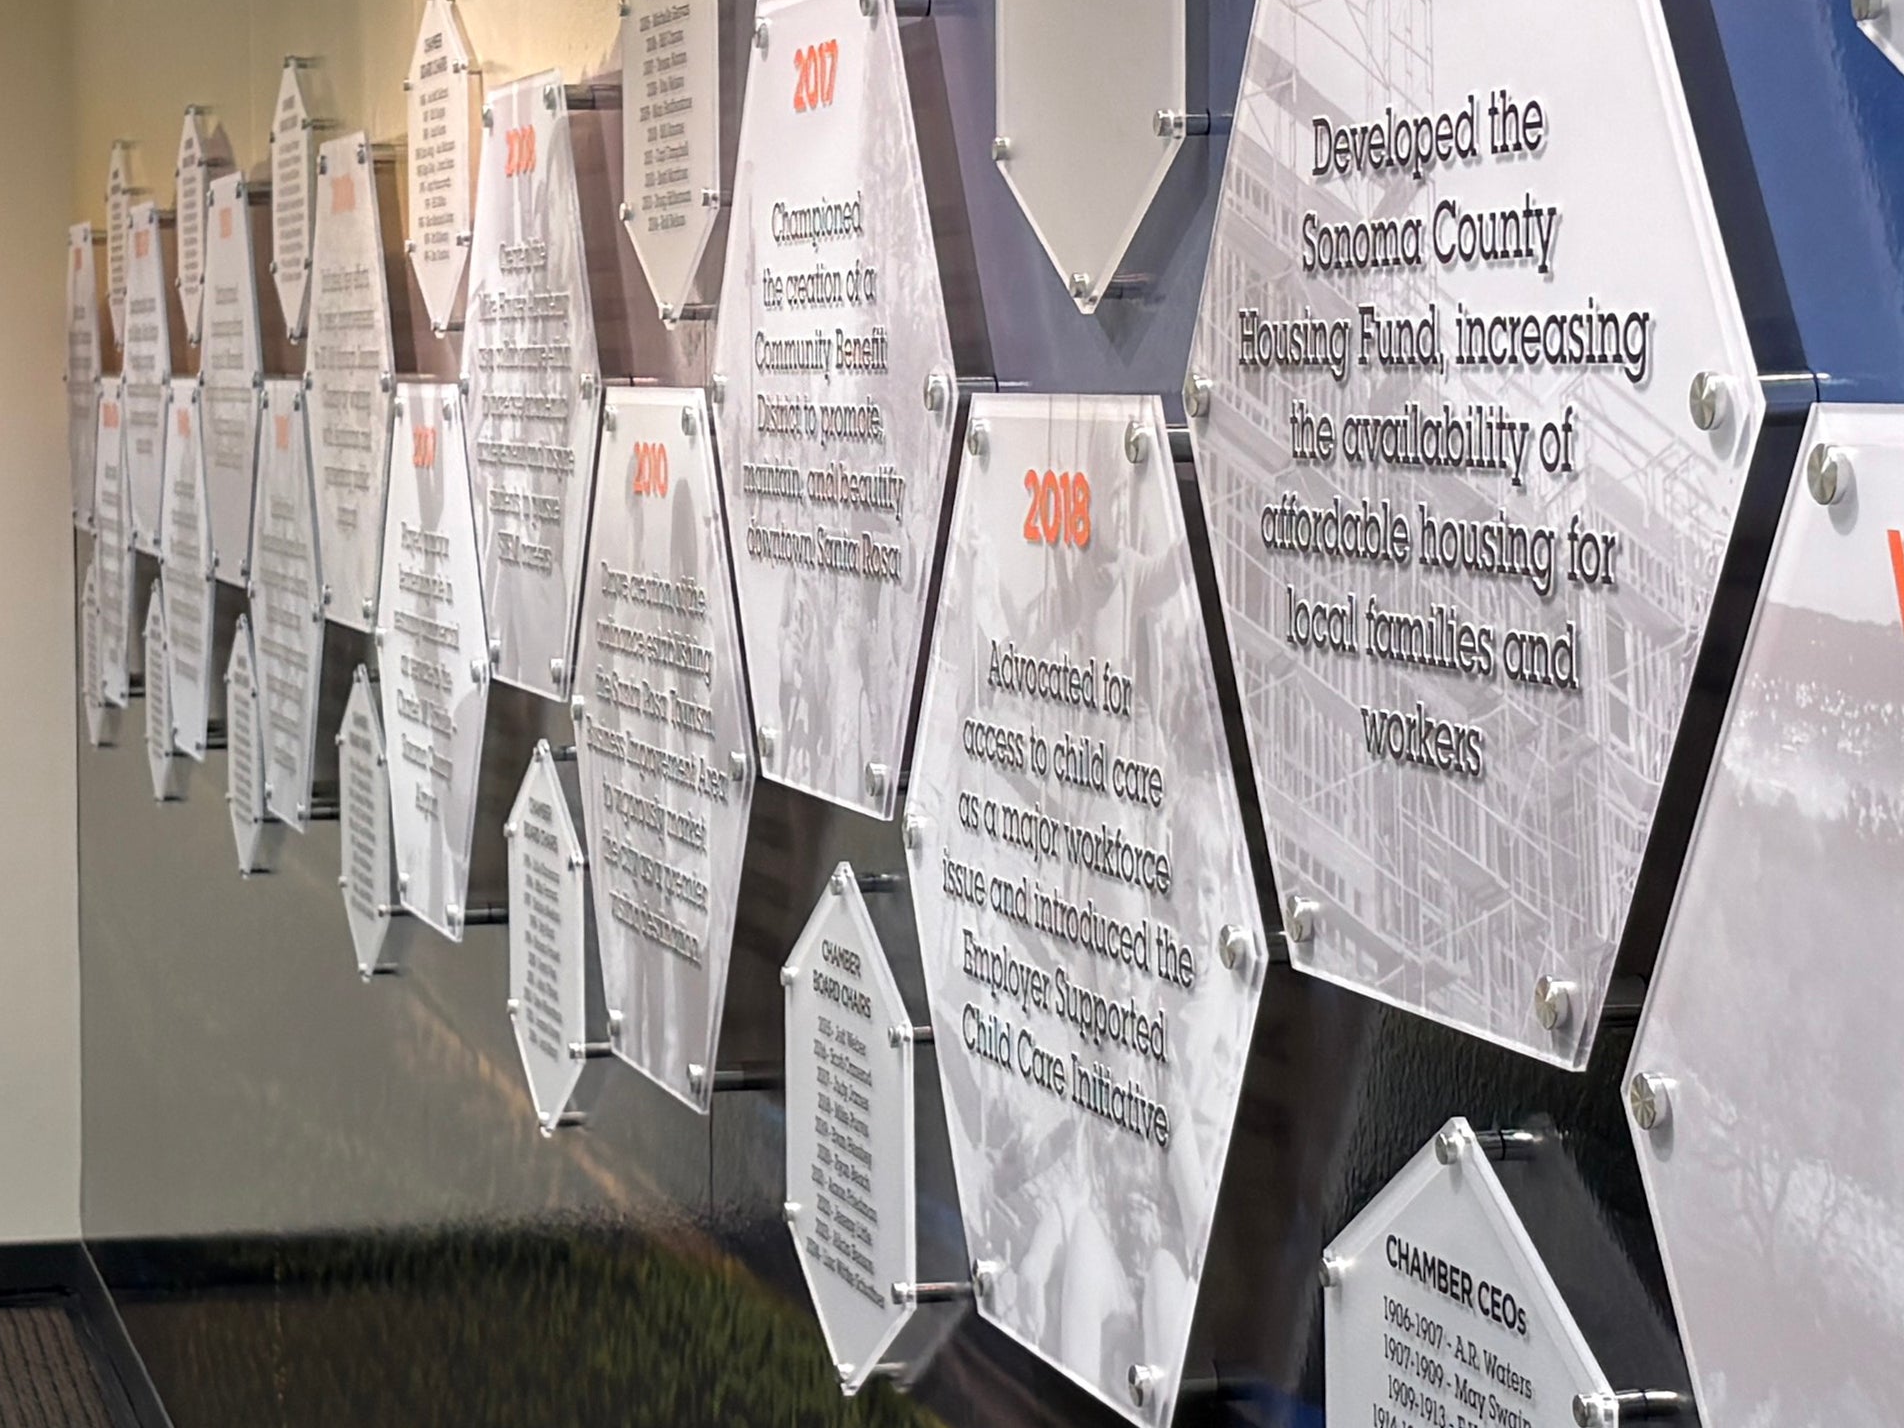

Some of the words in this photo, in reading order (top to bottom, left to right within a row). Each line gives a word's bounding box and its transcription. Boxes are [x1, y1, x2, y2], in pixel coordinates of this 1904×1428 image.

[1312, 93, 1477, 180] Developed
[1488, 86, 1544, 155] the
[1302, 213, 1422, 272] Sonoma
[1433, 192, 1556, 274] County
[1238, 308, 1349, 380] Housing
[1357, 302, 1446, 374] Fund,
[1455, 296, 1650, 381] increasing
[1290, 401, 1334, 459] the
[1342, 403, 1529, 487] availability
[1539, 405, 1575, 472] of
[1023, 468, 1090, 548] 2018
[1261, 493, 1410, 563] affordable
[1418, 503, 1556, 597] housing
[1566, 515, 1617, 587] for
[987, 639, 1096, 710] Advocated
[1103, 663, 1132, 719] for
[1286, 585, 1357, 653] local
[1365, 595, 1491, 676] families
[1503, 620, 1578, 690] and
[963, 719, 1024, 770] access
[1030, 725, 1047, 777] to
[1053, 735, 1105, 794] child
[1112, 760, 1164, 812] care
[1361, 702, 1482, 778] workers
[958, 791, 978, 830] as
[984, 799, 996, 837] a
[1002, 802, 1058, 862] major
[1064, 825, 1171, 898] workforce
[942, 846, 985, 907] issue
[990, 873, 1028, 924] and
[1034, 880, 1149, 973] introduced
[1156, 926, 1195, 992] the
[962, 926, 1049, 1012] Employer
[1055, 966, 1166, 1065] Supported
[962, 1000, 1011, 1070] Child
[1018, 1027, 1064, 1097] Care
[1071, 1053, 1170, 1151] Initiative
[1386, 1232, 1472, 1308] CHAMBER
[1478, 1277, 1526, 1336] CEOs
[1383, 1295, 1443, 1351] 1906-1907
[1483, 1348, 1532, 1400] Waters
[1383, 1333, 1443, 1391] 1907-1909
[1454, 1372, 1485, 1422] May
